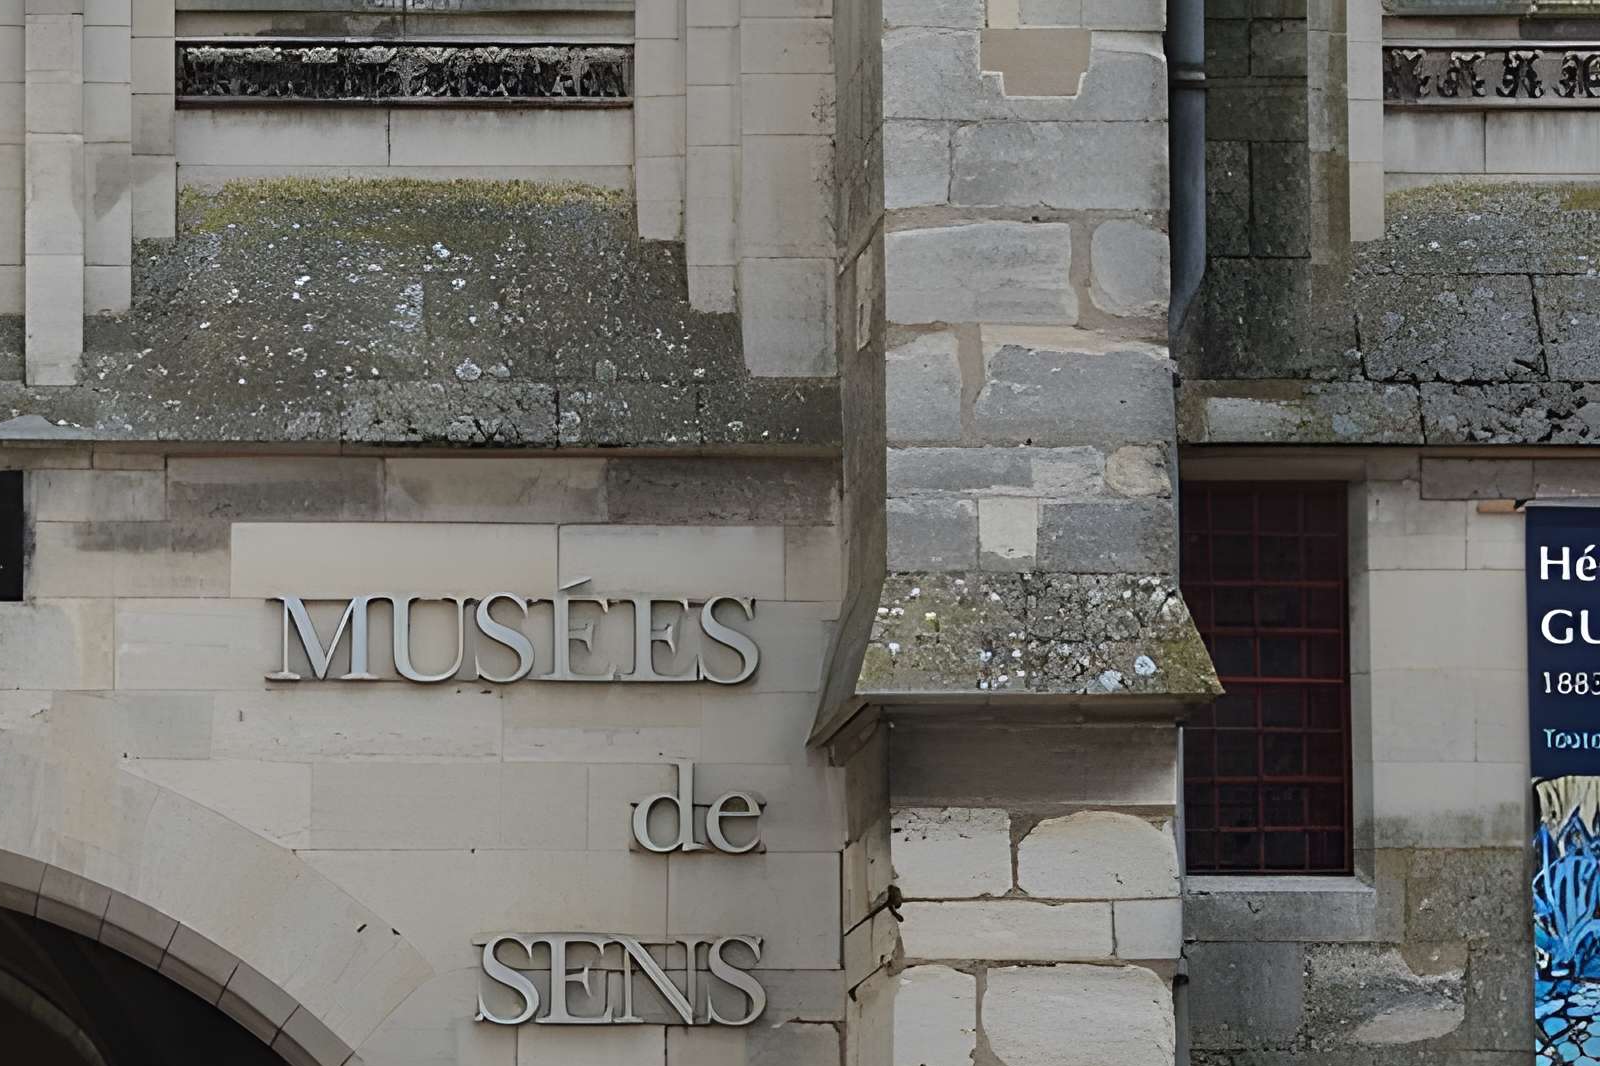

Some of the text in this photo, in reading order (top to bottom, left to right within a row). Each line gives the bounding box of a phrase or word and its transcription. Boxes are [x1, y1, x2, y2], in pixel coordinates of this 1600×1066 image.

[265, 577, 761, 685] MUSÉES
[630, 762, 767, 854] de
[475, 935, 768, 1027] SENS
